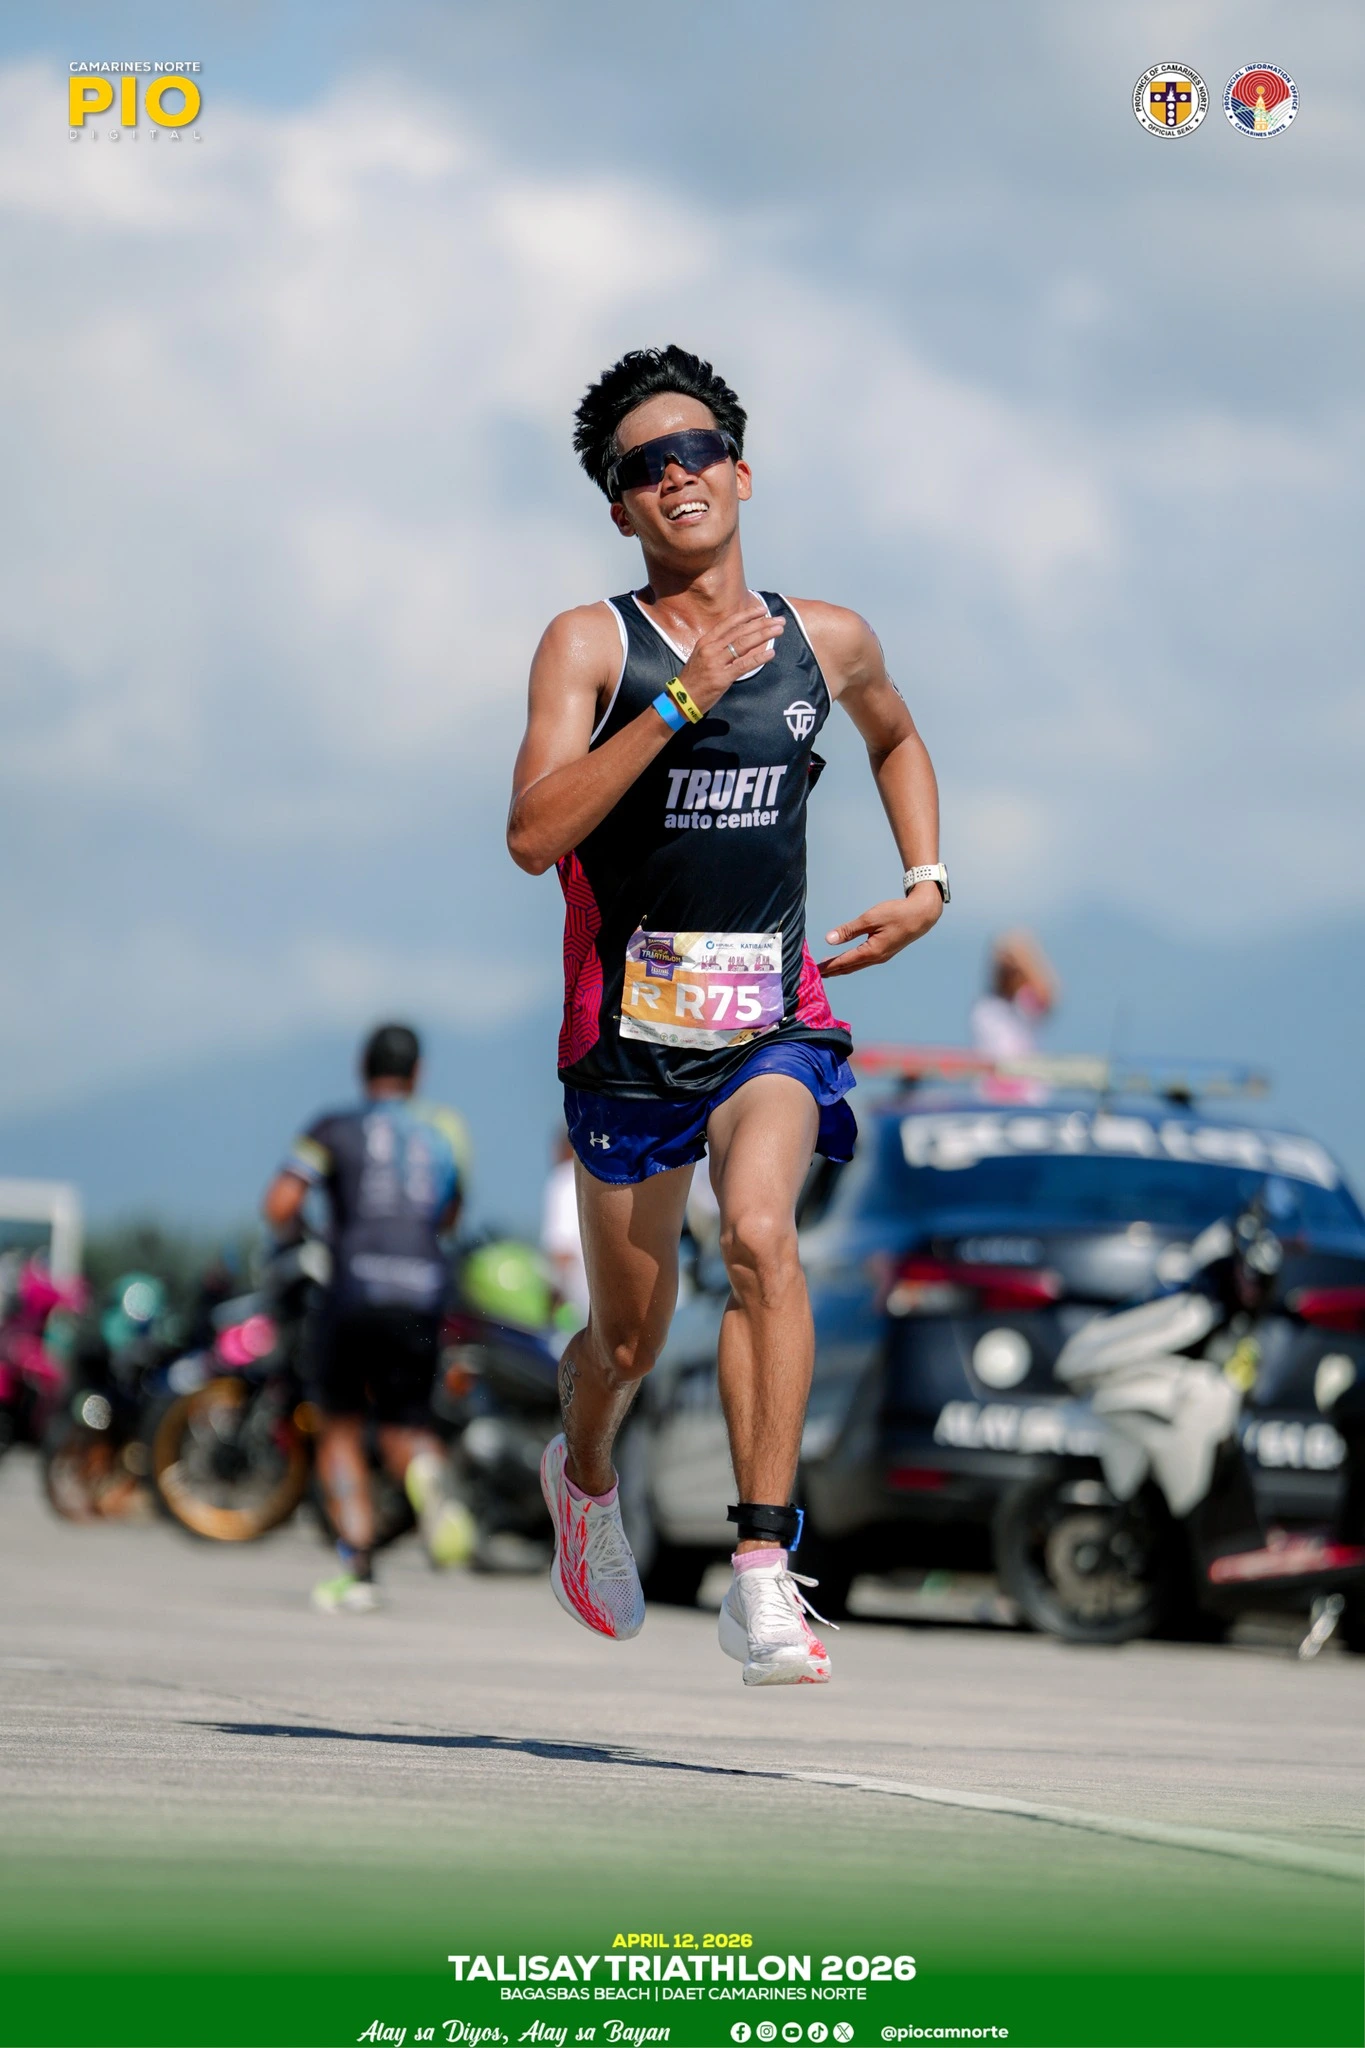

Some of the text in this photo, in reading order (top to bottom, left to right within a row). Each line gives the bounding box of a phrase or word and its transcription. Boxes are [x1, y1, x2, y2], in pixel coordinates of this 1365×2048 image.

[665, 765, 788, 810] TRUFIT
[664, 809, 779, 830] auto center
[631, 981, 762, 1021] R R75
